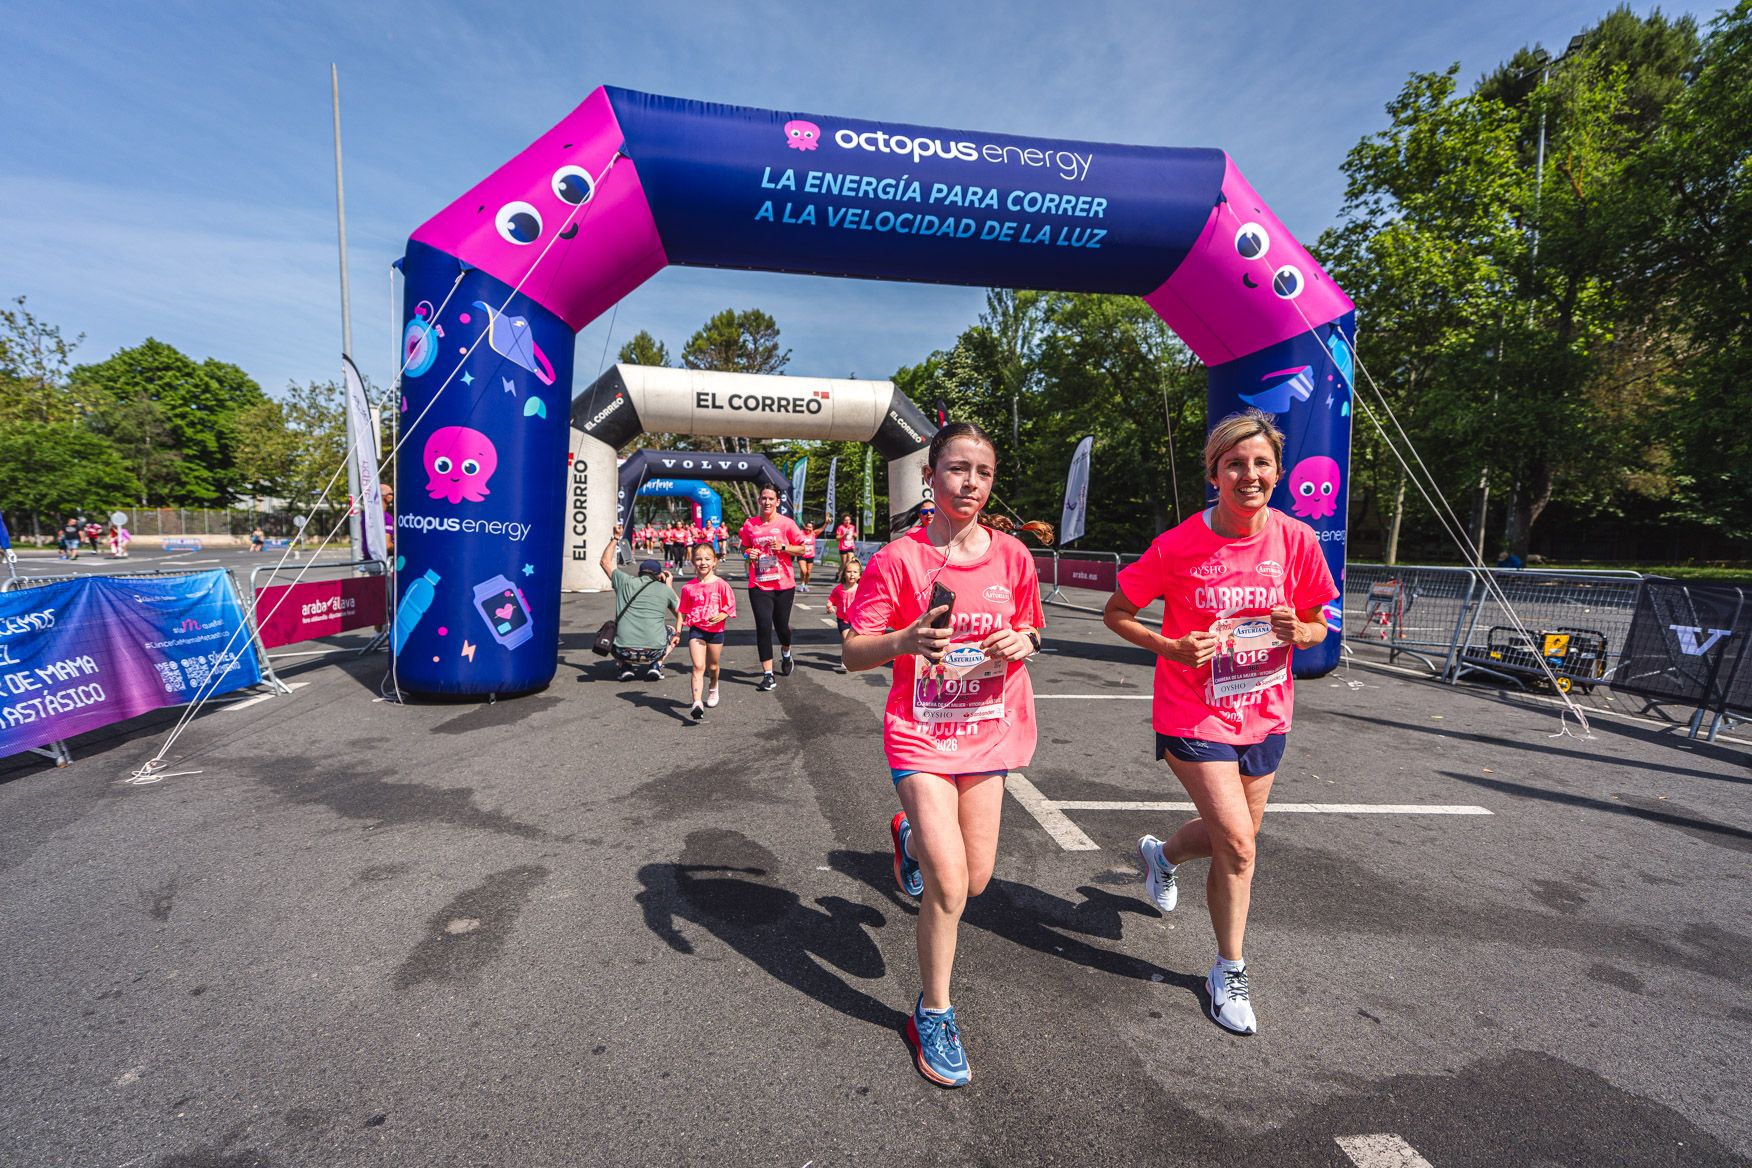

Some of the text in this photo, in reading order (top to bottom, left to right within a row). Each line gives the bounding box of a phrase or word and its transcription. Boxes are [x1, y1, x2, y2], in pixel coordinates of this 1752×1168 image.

[834, 129, 1093, 181] octopus energy
[760, 166, 1108, 219] LA ENERGÍA PARA CORRER
[754, 201, 1108, 249] A LA VELOCIDAD DE LA LUZ
[696, 391, 822, 415] EL CORREO
[584, 397, 625, 432] EL CORREO
[889, 410, 922, 443] EL CORREO
[662, 459, 749, 470] VOLVO
[573, 459, 588, 561] EL CORREO
[398, 512, 532, 542] octopus energy
[1190, 565, 1227, 576] OYSHO
[302, 599, 327, 616] araba
[1195, 586, 1278, 609] CARRERA
[1236, 626, 1270, 635] ASTURIANA
[948, 654, 983, 663] ASTURIANA
[1236, 649, 1269, 665] 016
[4, 671, 43, 695] DE
[34, 655, 99, 685] MAMA
[945, 680, 980, 694] 016
[1221, 683, 1246, 692] OYSHO
[923, 711, 953, 719] OYSHO
[936, 738, 958, 751] 2026
